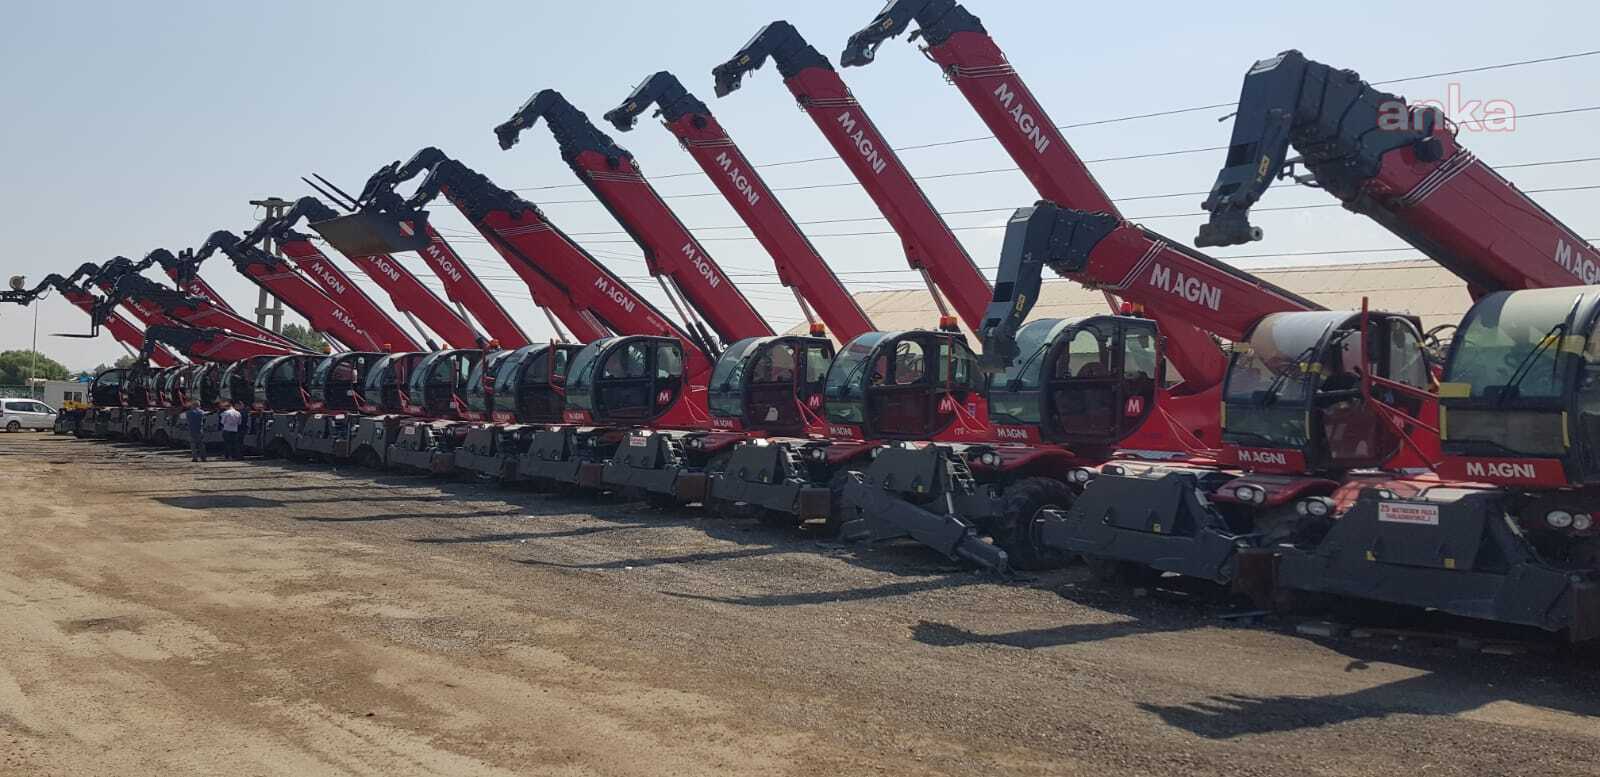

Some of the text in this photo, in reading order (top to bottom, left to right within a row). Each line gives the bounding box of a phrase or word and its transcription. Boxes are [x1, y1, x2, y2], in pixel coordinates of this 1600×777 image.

[994, 83, 1050, 154] MAGNI
[837, 111, 887, 174] MAGNI
[716, 152, 759, 206] MAGNI
[312, 262, 345, 295] MAGNI
[427, 245, 461, 282] MAGNI
[682, 243, 720, 288] MAGNI
[595, 277, 635, 312] MAGNI
[1150, 263, 1221, 311] MAGNI
[941, 399, 952, 411] M
[1128, 399, 1140, 412] M
[997, 428, 1028, 438] MAGNI
[1238, 450, 1286, 464] MAGNI
[1466, 462, 1536, 478] MAGNI
